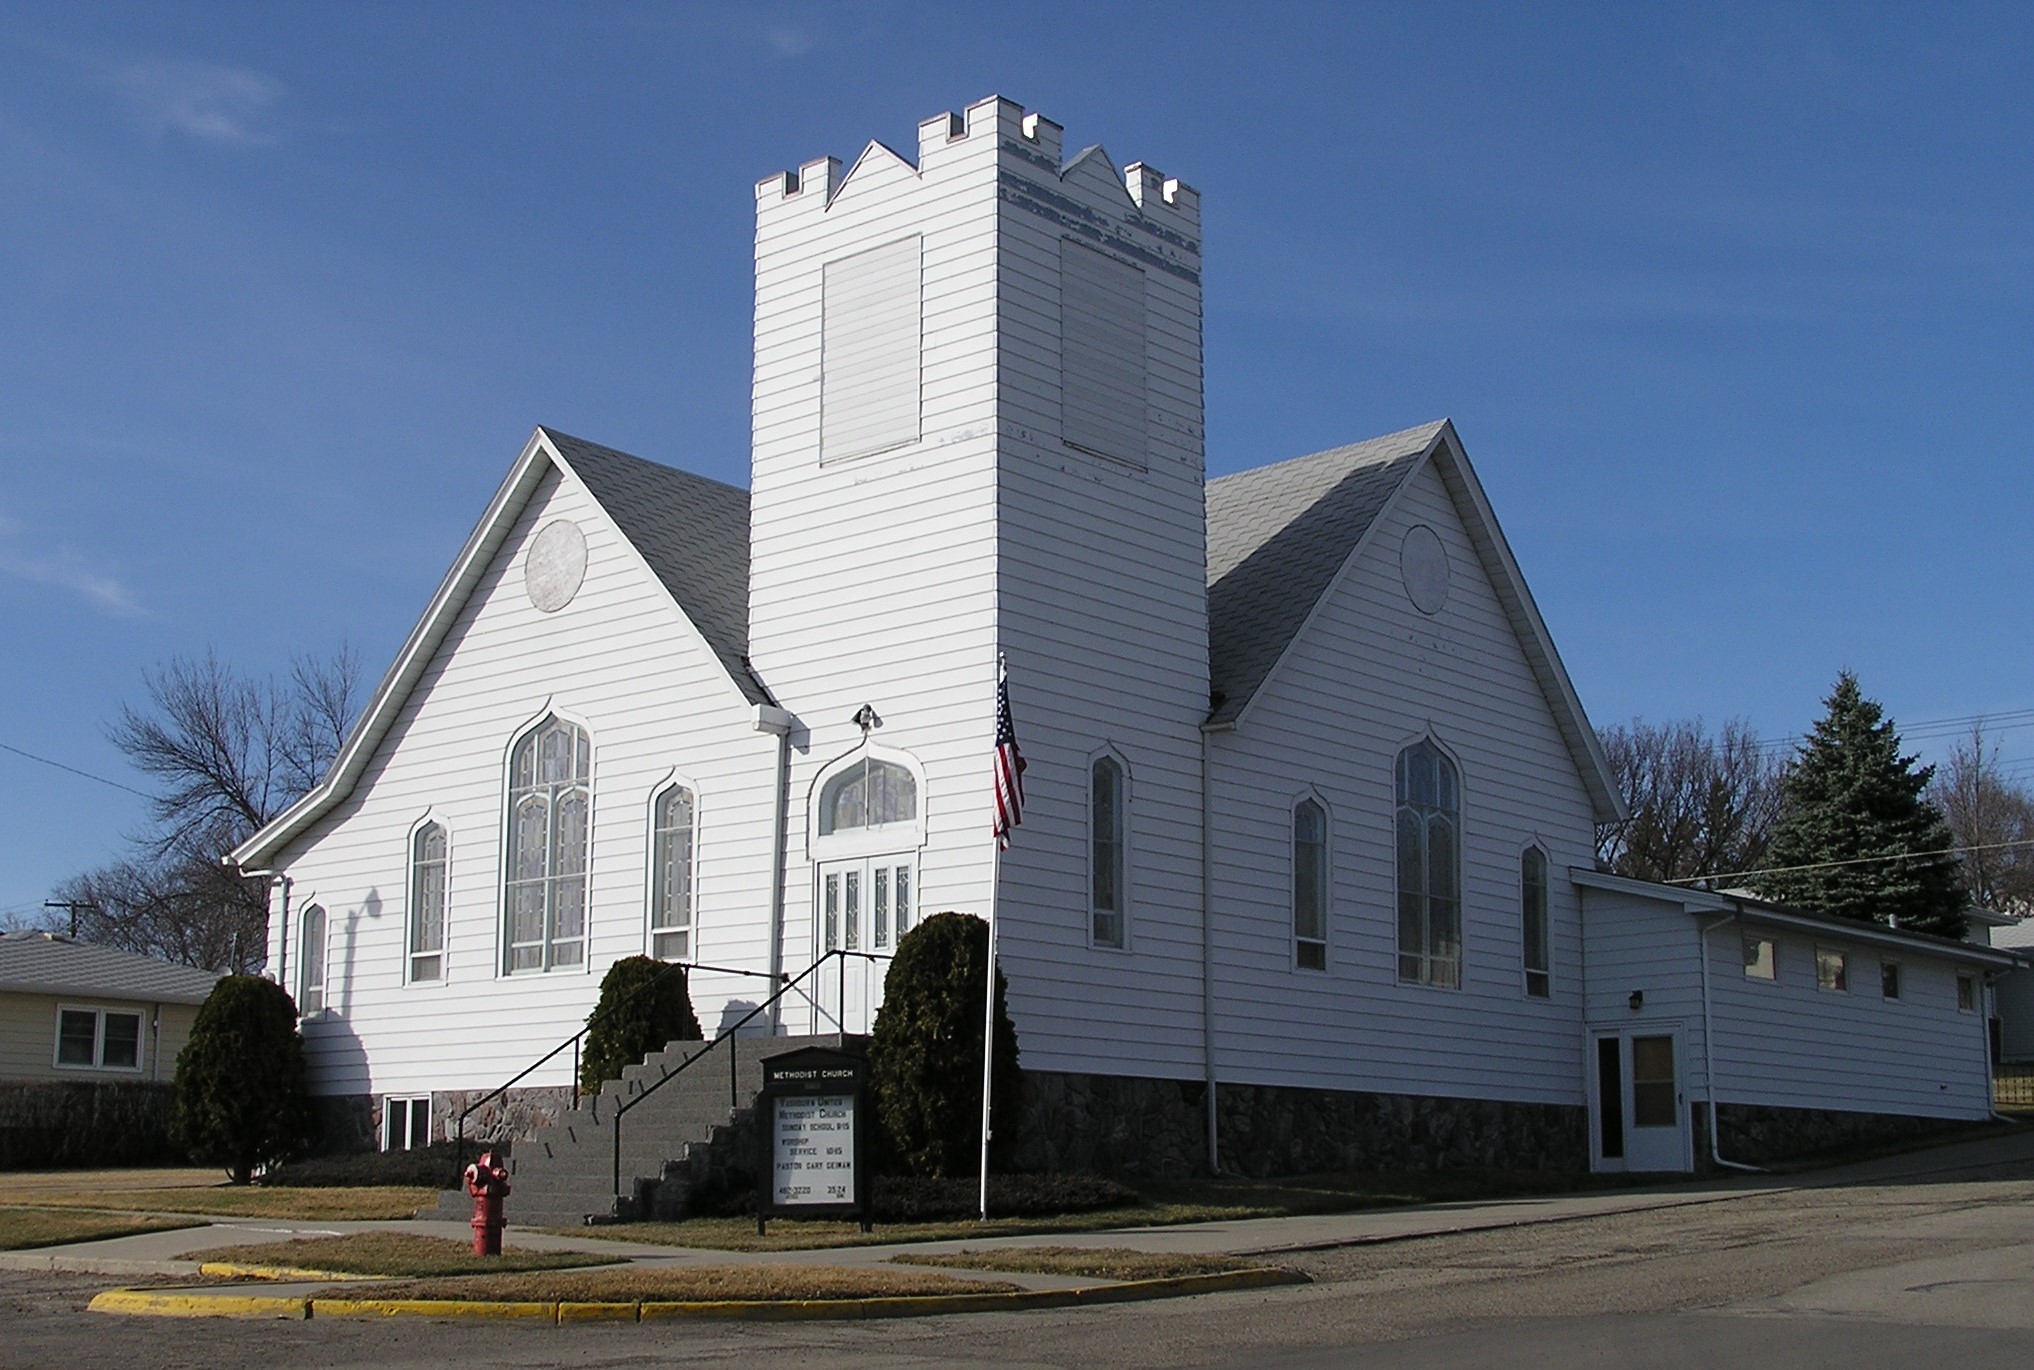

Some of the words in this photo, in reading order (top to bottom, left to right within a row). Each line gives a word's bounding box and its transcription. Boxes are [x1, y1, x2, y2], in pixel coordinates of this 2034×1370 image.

[773, 1070, 817, 1079] METHODIST
[821, 1070, 853, 1078] CHURCH
[789, 1147, 817, 1156] SERVICE
[776, 1162, 802, 1170] PASTOR
